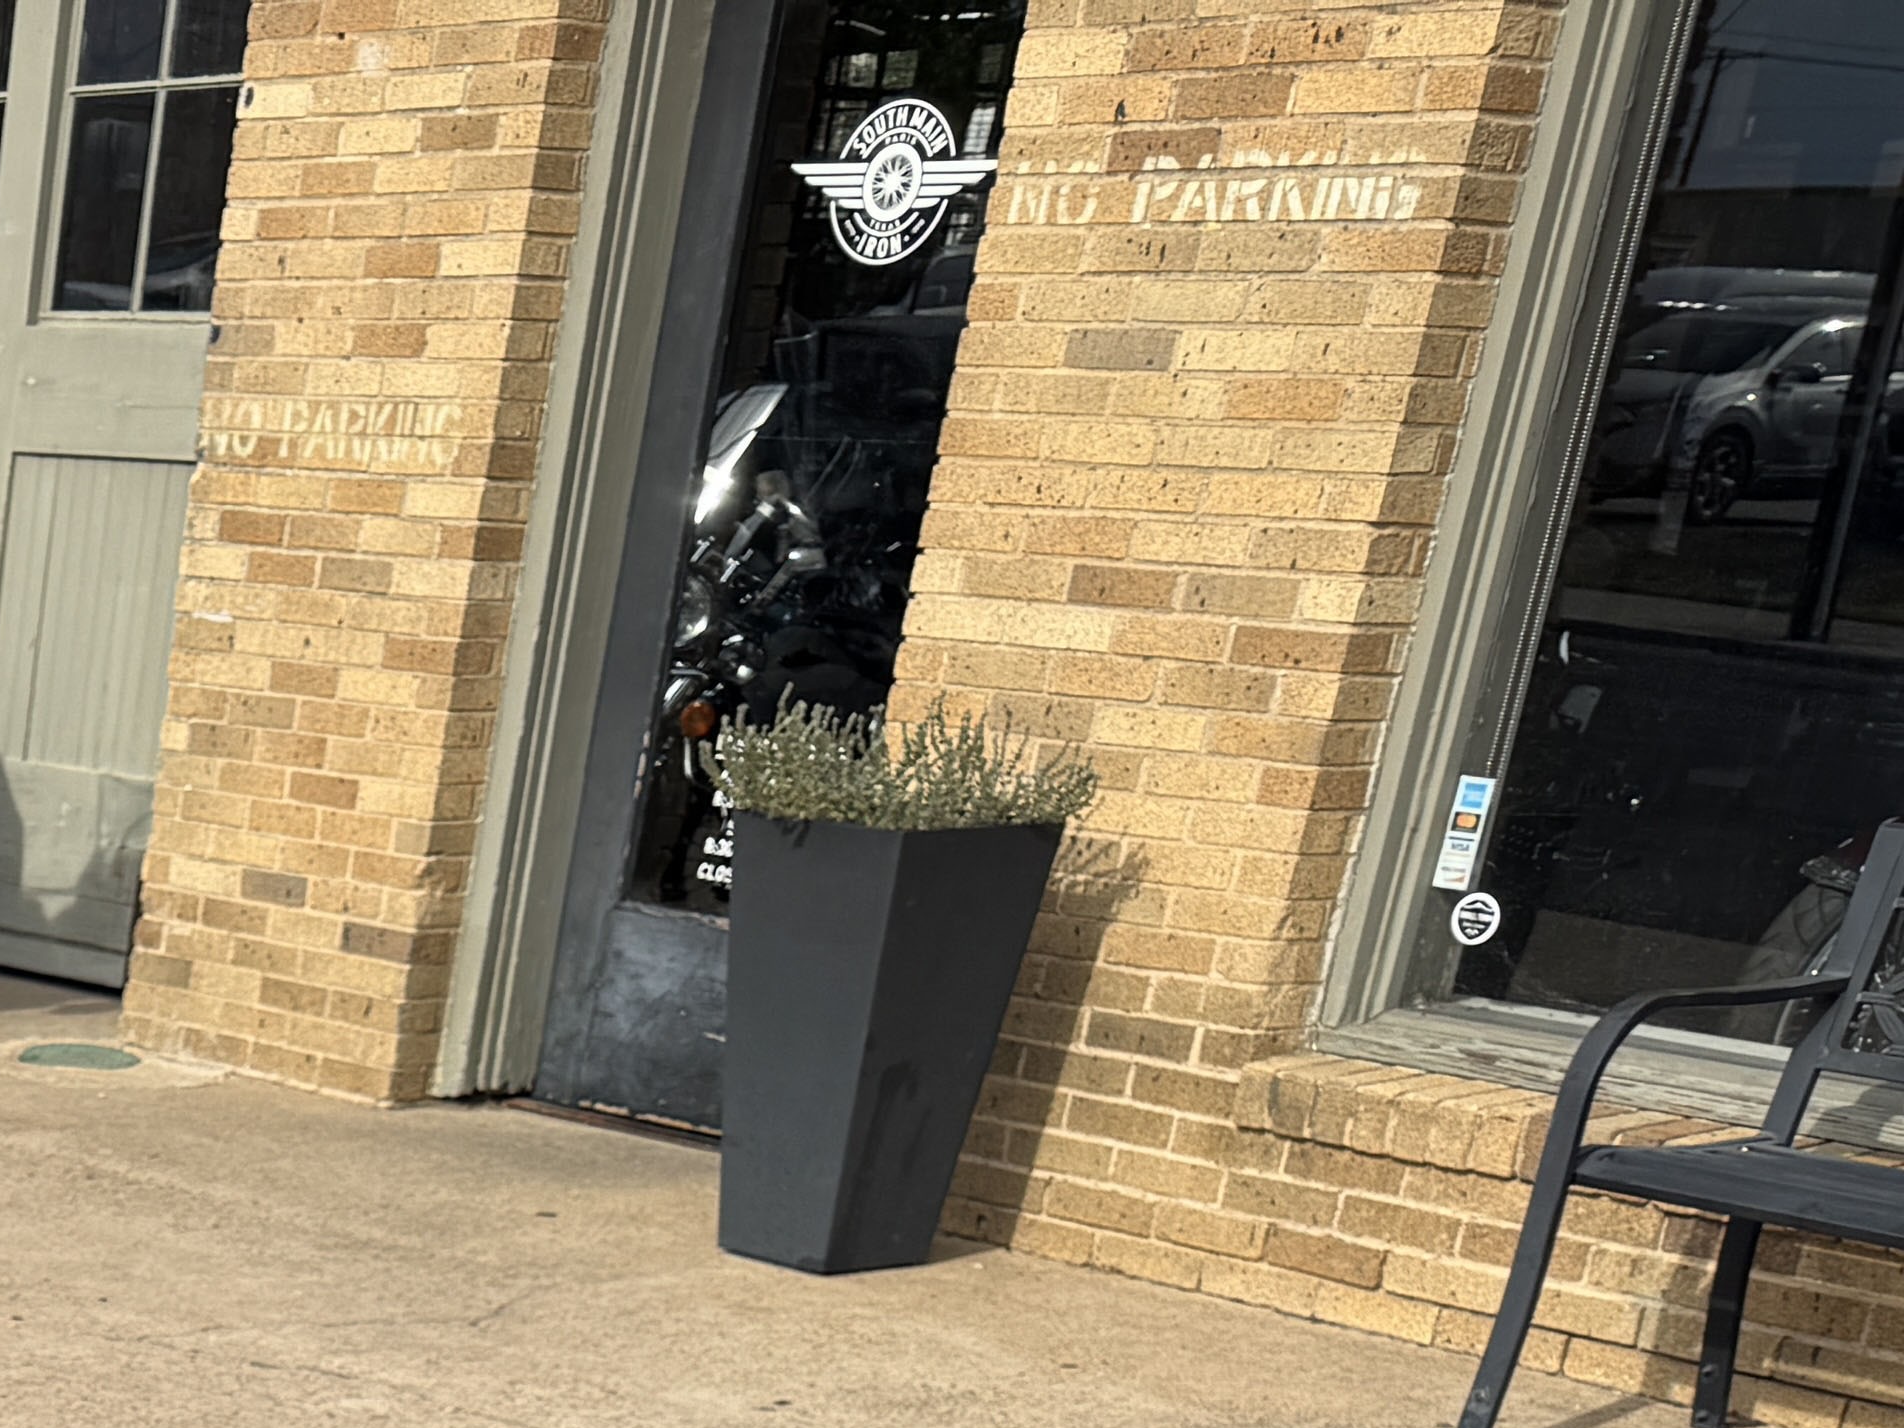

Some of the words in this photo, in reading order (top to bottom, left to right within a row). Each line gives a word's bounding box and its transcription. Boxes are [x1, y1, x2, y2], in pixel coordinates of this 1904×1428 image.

[852, 105, 910, 156] SOUTH
[909, 106, 949, 155] MAIN
[1130, 149, 1428, 223] PARKING
[856, 233, 903, 259] IRON
[277, 400, 463, 467] PARKING
